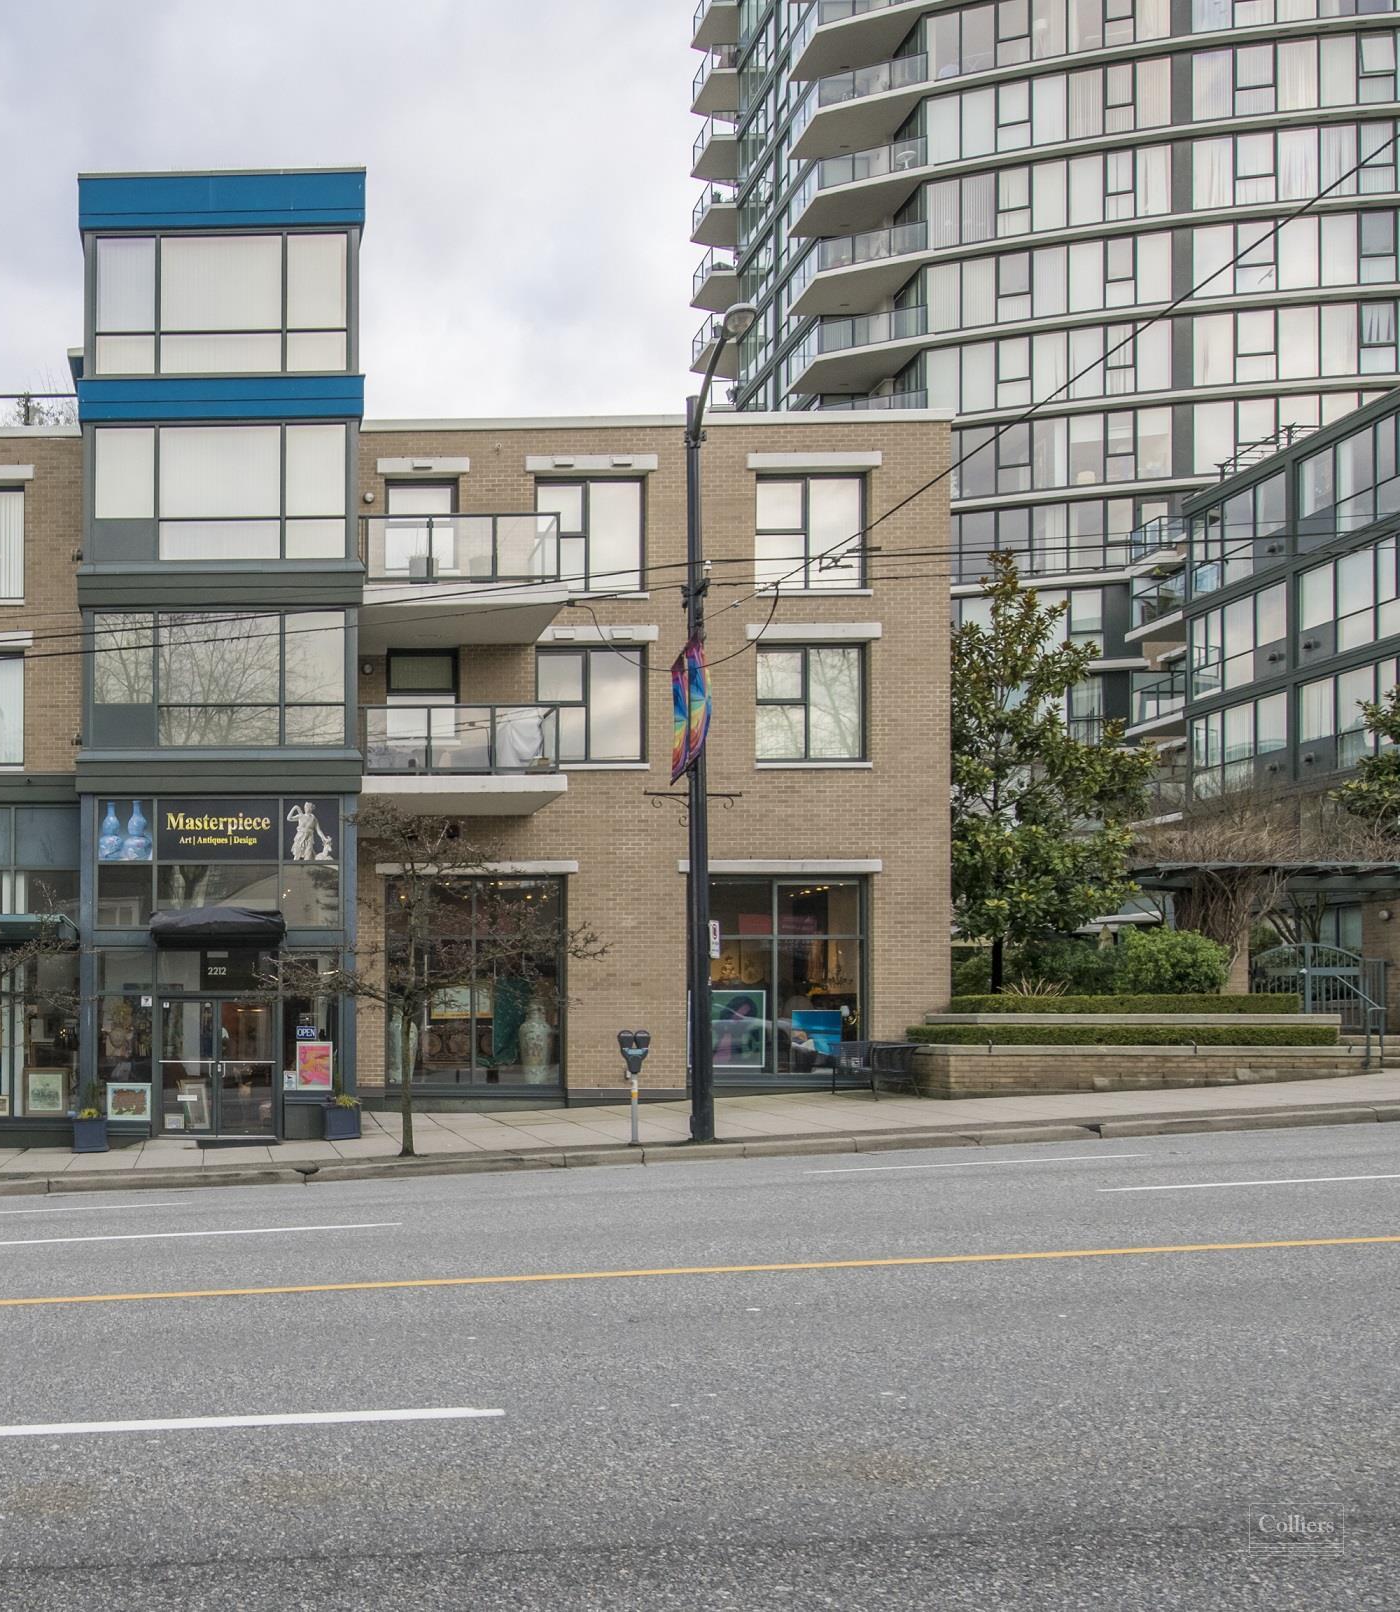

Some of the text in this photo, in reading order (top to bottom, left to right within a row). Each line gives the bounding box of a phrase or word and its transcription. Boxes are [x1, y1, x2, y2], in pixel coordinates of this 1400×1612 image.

[166, 812, 271, 835] Masterpiece
[179, 836, 192, 844] Art
[197, 836, 228, 846] Antiques
[233, 836, 257, 846] Design
[207, 966, 227, 976] 2212
[296, 1028, 315, 1037] OPEN
